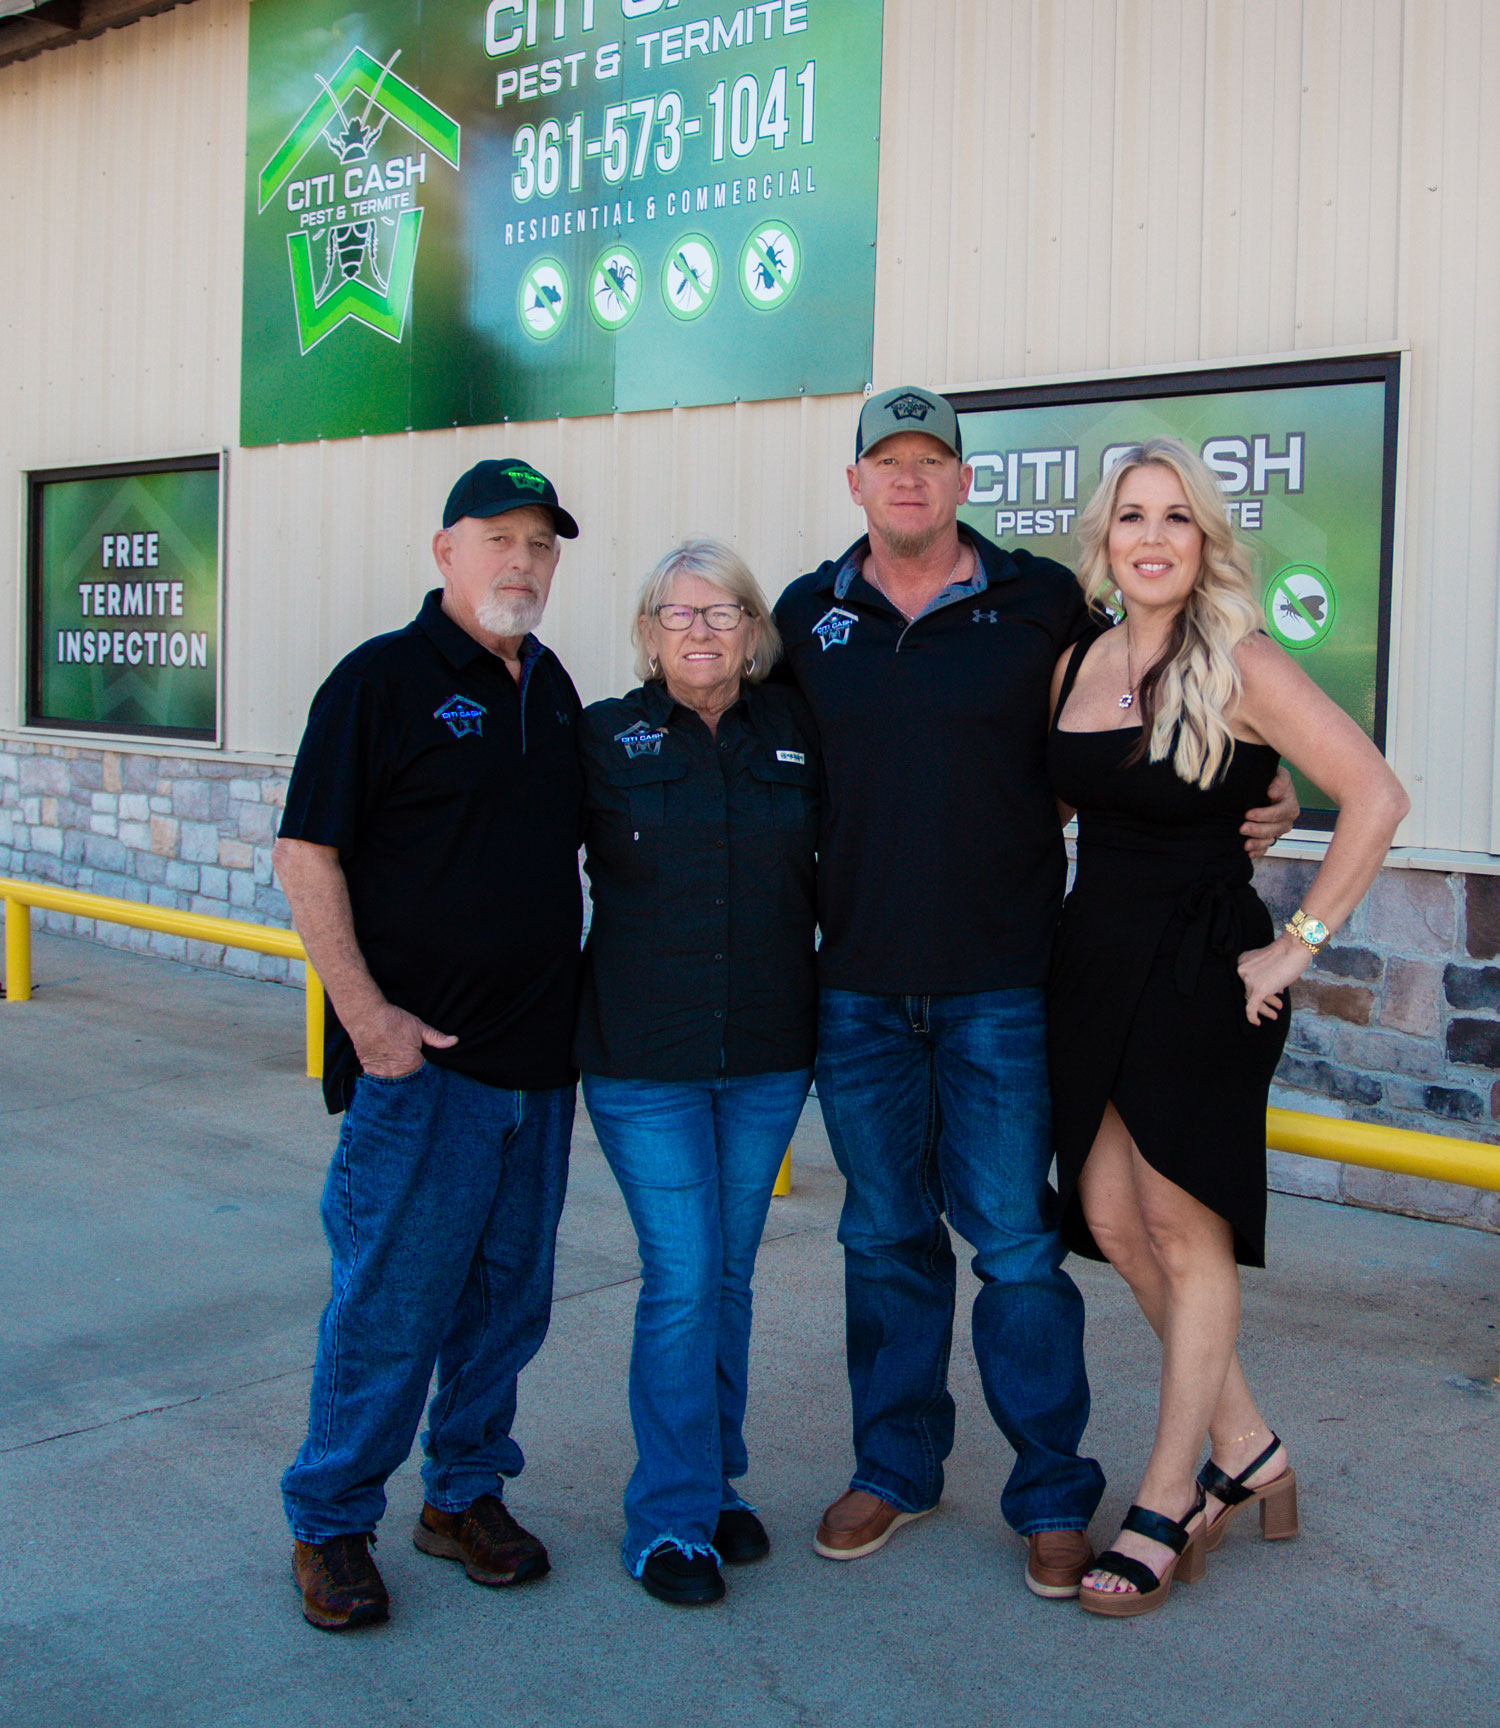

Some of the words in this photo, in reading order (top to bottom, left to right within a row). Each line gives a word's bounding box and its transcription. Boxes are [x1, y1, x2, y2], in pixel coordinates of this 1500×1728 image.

[496, 51, 587, 107] PEST
[594, 41, 621, 80] &
[636, 1, 808, 69] TERMITE
[513, 61, 816, 201] 361-573-1041
[287, 173, 335, 213] CITI
[344, 152, 426, 199] CASH
[504, 200, 636, 246] RESIDENTIAL
[646, 196, 656, 220] &
[667, 167, 816, 217] COMMERCIAL
[300, 207, 334, 228] PEST
[335, 205, 346, 220] &
[351, 192, 410, 217] TERMITE
[967, 448, 1077, 503] CITI
[1101, 431, 1304, 495] SH
[996, 509, 1075, 536] PEST
[102, 533, 159, 568] FREE
[78, 582, 184, 616] TERMITE
[58, 631, 207, 667] INSPECTION
